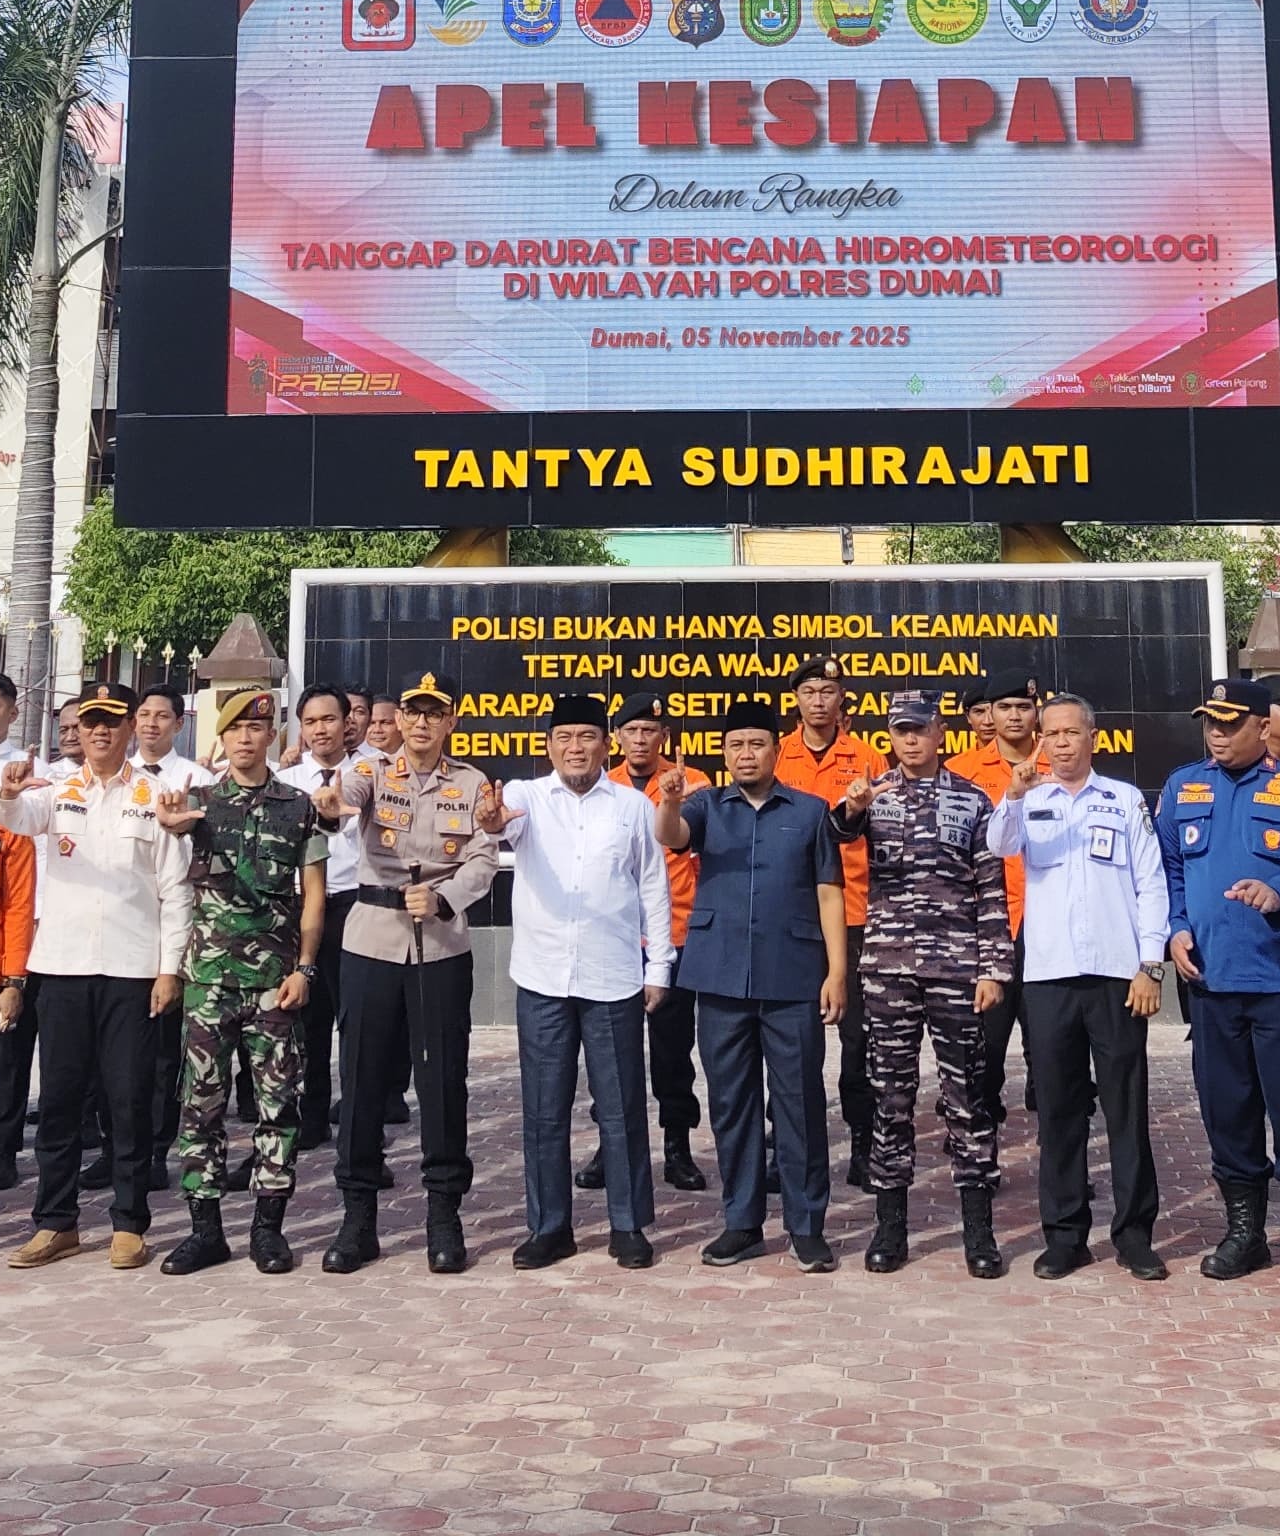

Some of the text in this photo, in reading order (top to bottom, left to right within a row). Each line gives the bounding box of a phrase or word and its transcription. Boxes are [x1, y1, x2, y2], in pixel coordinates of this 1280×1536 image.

[365, 77, 1136, 151] APEL KESIAPAN
[609, 172, 902, 219] Dalam Rangka
[282, 233, 1219, 270] TANGGAP DARURAT BENCANA HIDROMETEOROLOGI
[503, 269, 1001, 299] DI WILAYAH POLRES DUMAI
[590, 325, 911, 350] Dumai, 05 November 2025
[1141, 373, 1176, 384] Melayu
[414, 445, 1090, 489] TANTYA SUDHIRAJATI
[452, 613, 1059, 641] POLISI BUKAN HANYA SIMBOL KEAMANAN
[523, 654, 622, 679] TETAPI
[631, 653, 712, 678] JUGA
[453, 693, 577, 717] ARAPA
[122, 808, 156, 821] POL-PP
[436, 802, 469, 812] POLRI
[942, 814, 973, 828] TNI AL
